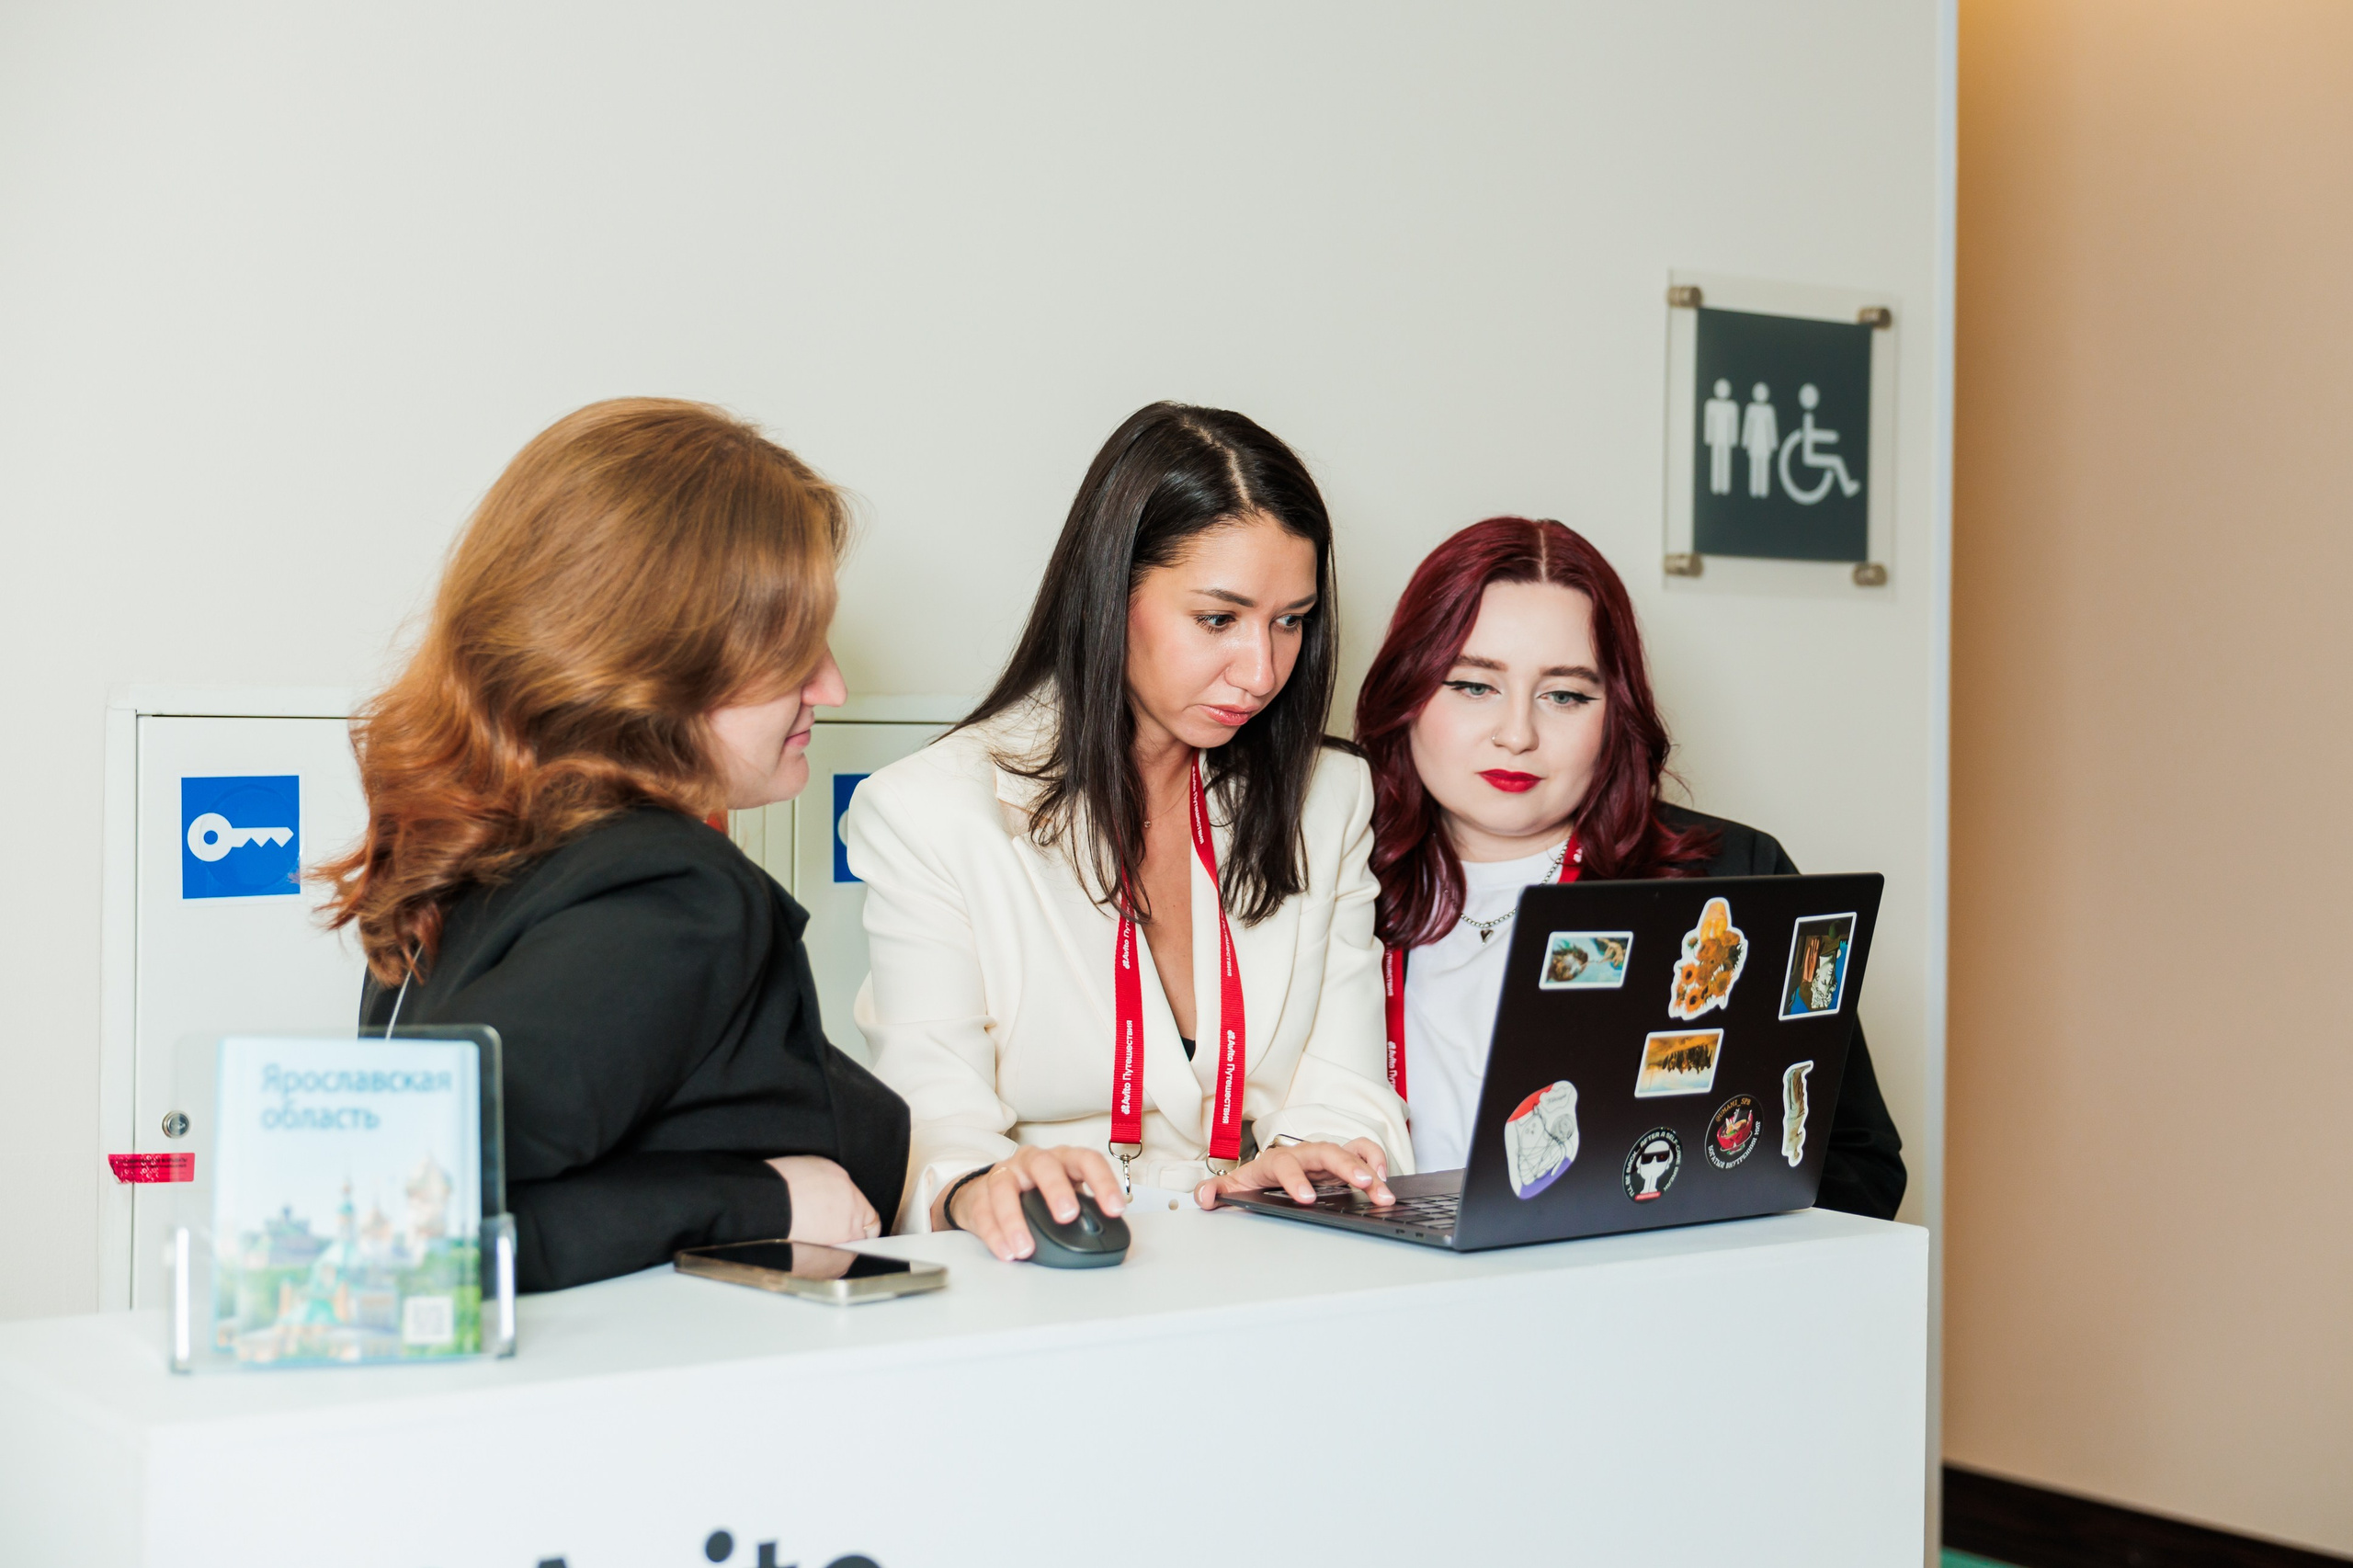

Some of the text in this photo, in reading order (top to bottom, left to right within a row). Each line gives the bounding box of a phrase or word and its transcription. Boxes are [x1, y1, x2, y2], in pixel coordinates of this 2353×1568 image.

[1121, 1019, 1134, 1106] Avito Путешествия
[1388, 1050, 1397, 1069] Avito
[261, 1062, 452, 1100] Ярославская
[1222, 1039, 1235, 1124] Avito Путешествия
[261, 1098, 381, 1131] область
[1715, 1097, 1752, 1122] @UMAMI_SPB
[1640, 1131, 1660, 1148] AFTER
[1663, 1166, 1679, 1192] BREAK
